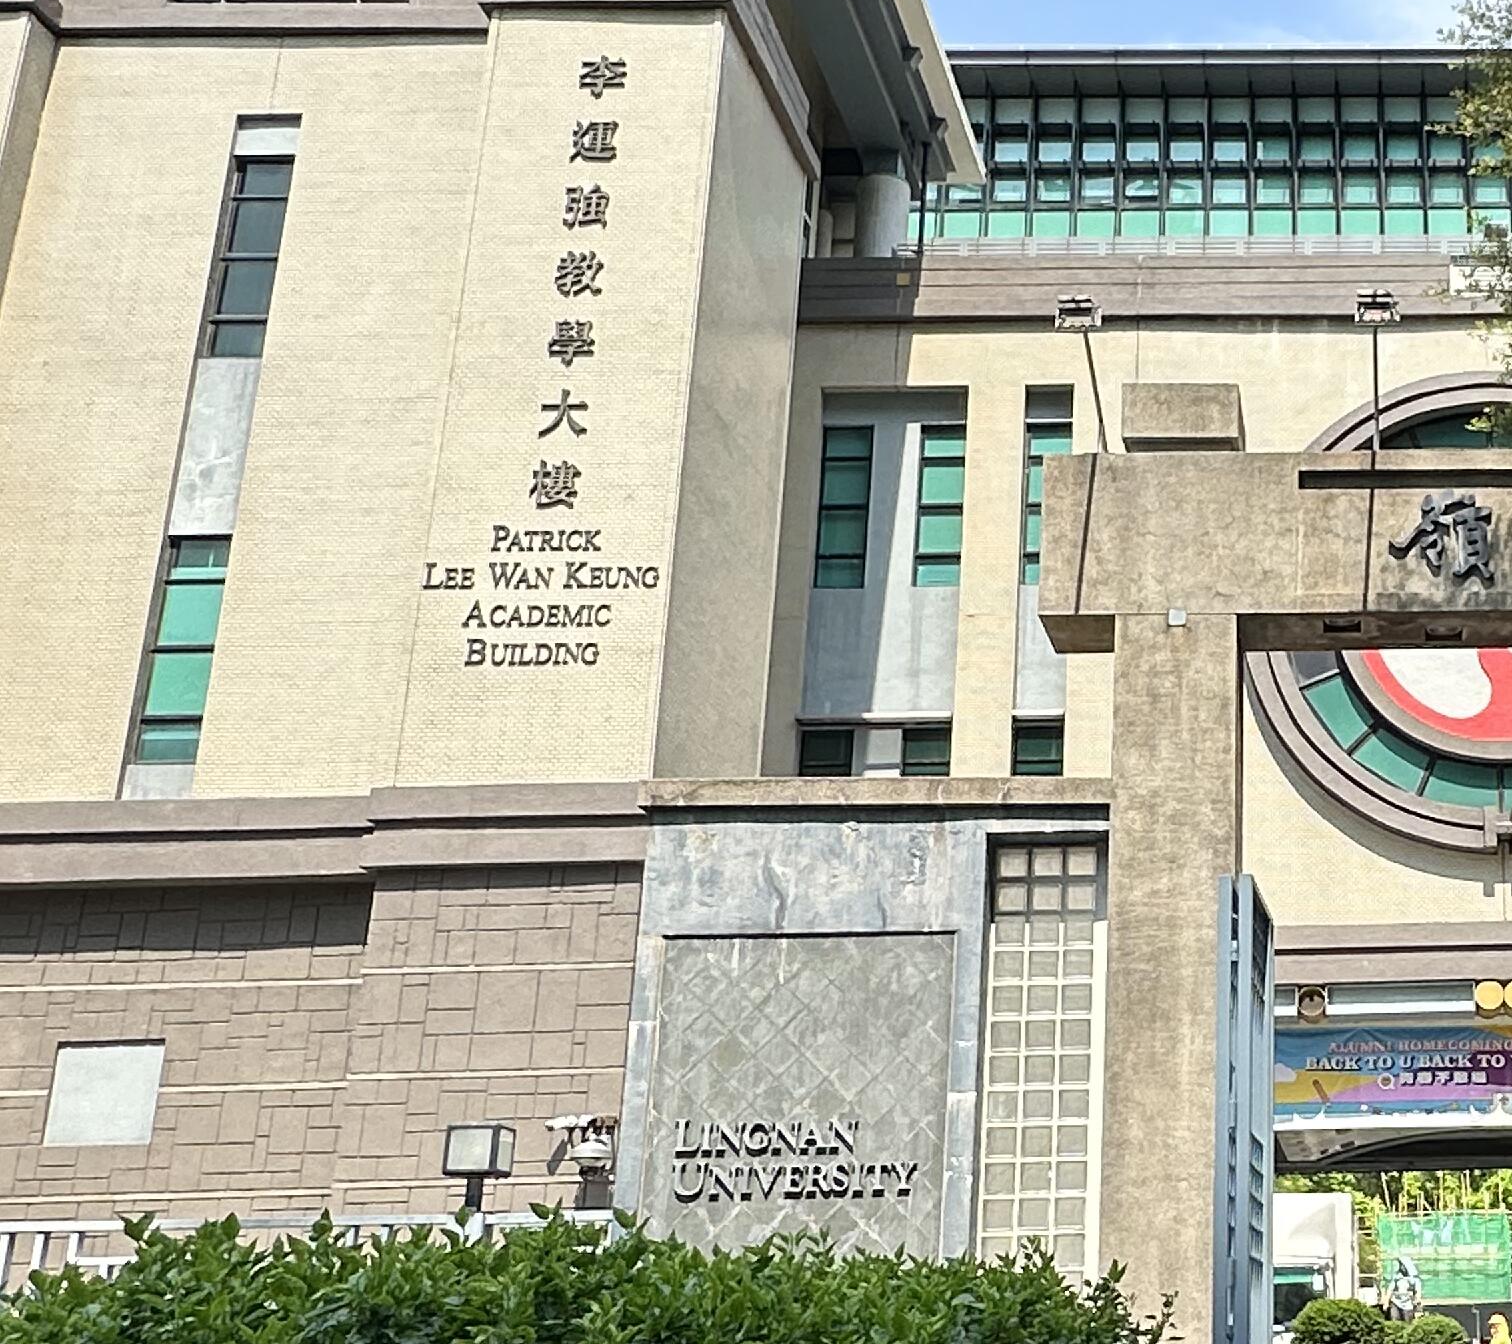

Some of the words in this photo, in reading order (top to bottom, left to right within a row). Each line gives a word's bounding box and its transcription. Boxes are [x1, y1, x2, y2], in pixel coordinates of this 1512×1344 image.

[529, 55, 627, 510] 李運強教學大樓
[1305, 1056, 1361, 1071] BACK
[1363, 1055, 1395, 1070] TO
[1399, 1054, 1415, 1070] U
[1419, 1054, 1474, 1068] BACK
[1477, 1054, 1506, 1068] TO
[1328, 1041, 1392, 1053] ALUMNI
[674, 1119, 860, 1158] LINGNAN
[672, 1159, 918, 1203] UNIVERSITY
